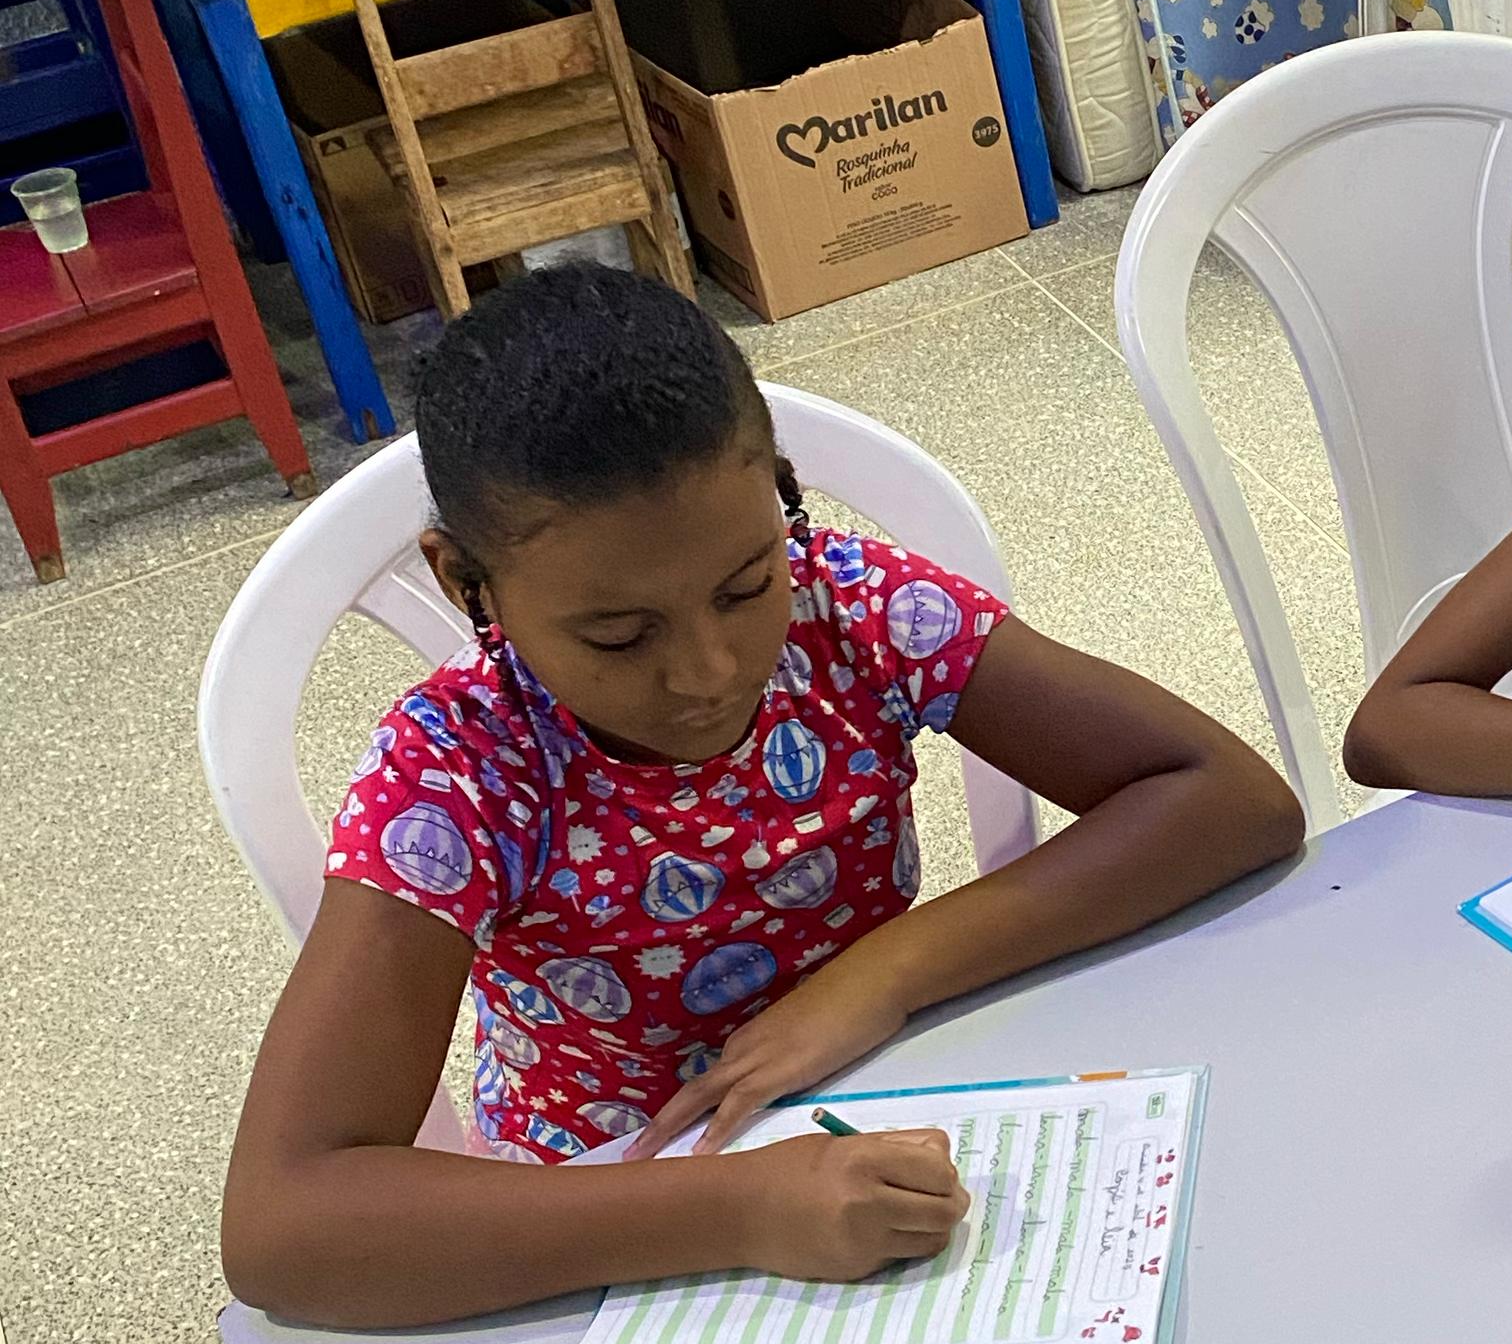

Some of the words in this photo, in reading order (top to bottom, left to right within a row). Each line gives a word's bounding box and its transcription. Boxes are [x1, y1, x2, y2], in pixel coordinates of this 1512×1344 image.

[776, 89, 948, 169] Marilan
[836, 137, 911, 177] Rosquinha
[840, 151, 918, 194] Tradicional
